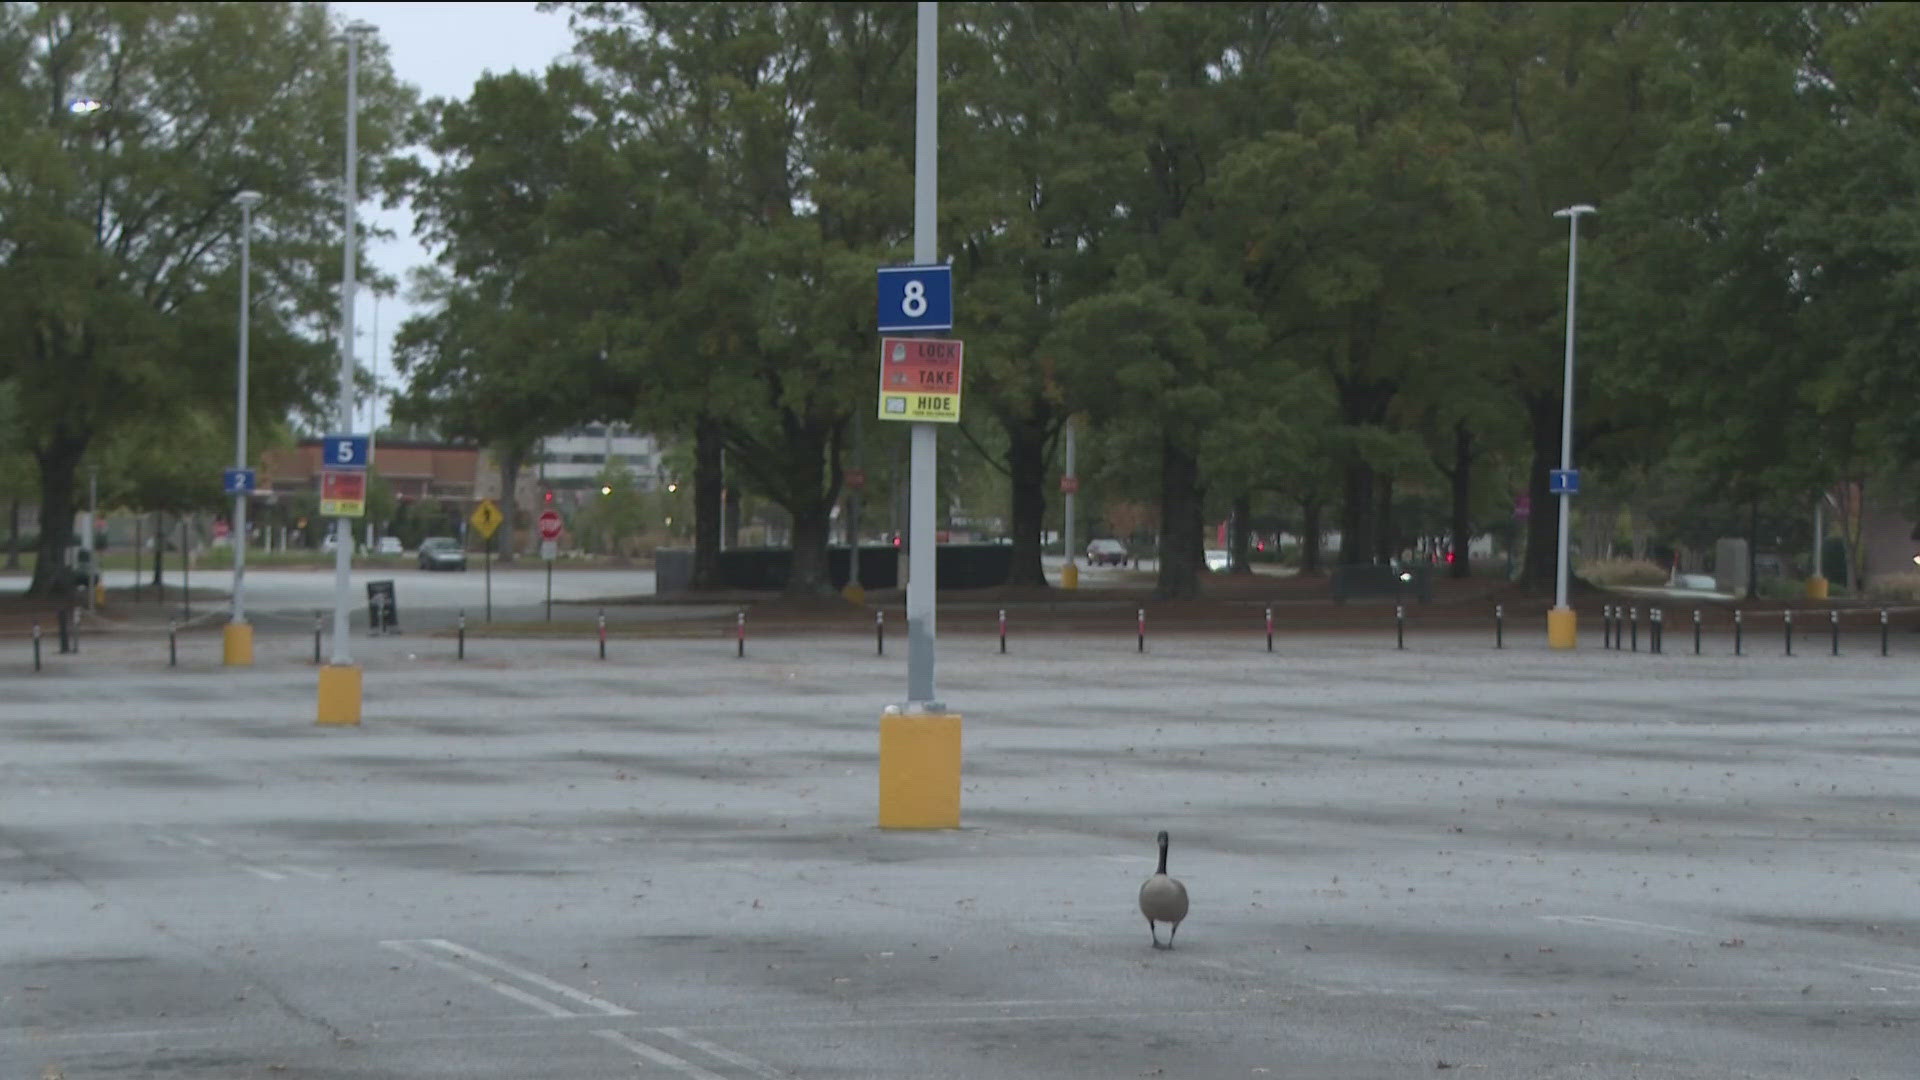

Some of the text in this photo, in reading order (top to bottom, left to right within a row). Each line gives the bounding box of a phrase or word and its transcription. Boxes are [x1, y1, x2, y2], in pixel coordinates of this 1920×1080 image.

[901, 279, 928, 318] 8
[918, 343, 957, 358] LOCK
[918, 370, 954, 385] TAKE
[917, 396, 951, 411] HIDE
[337, 440, 355, 464] 5
[234, 473, 247, 489] 2
[1560, 474, 1566, 488] 1
